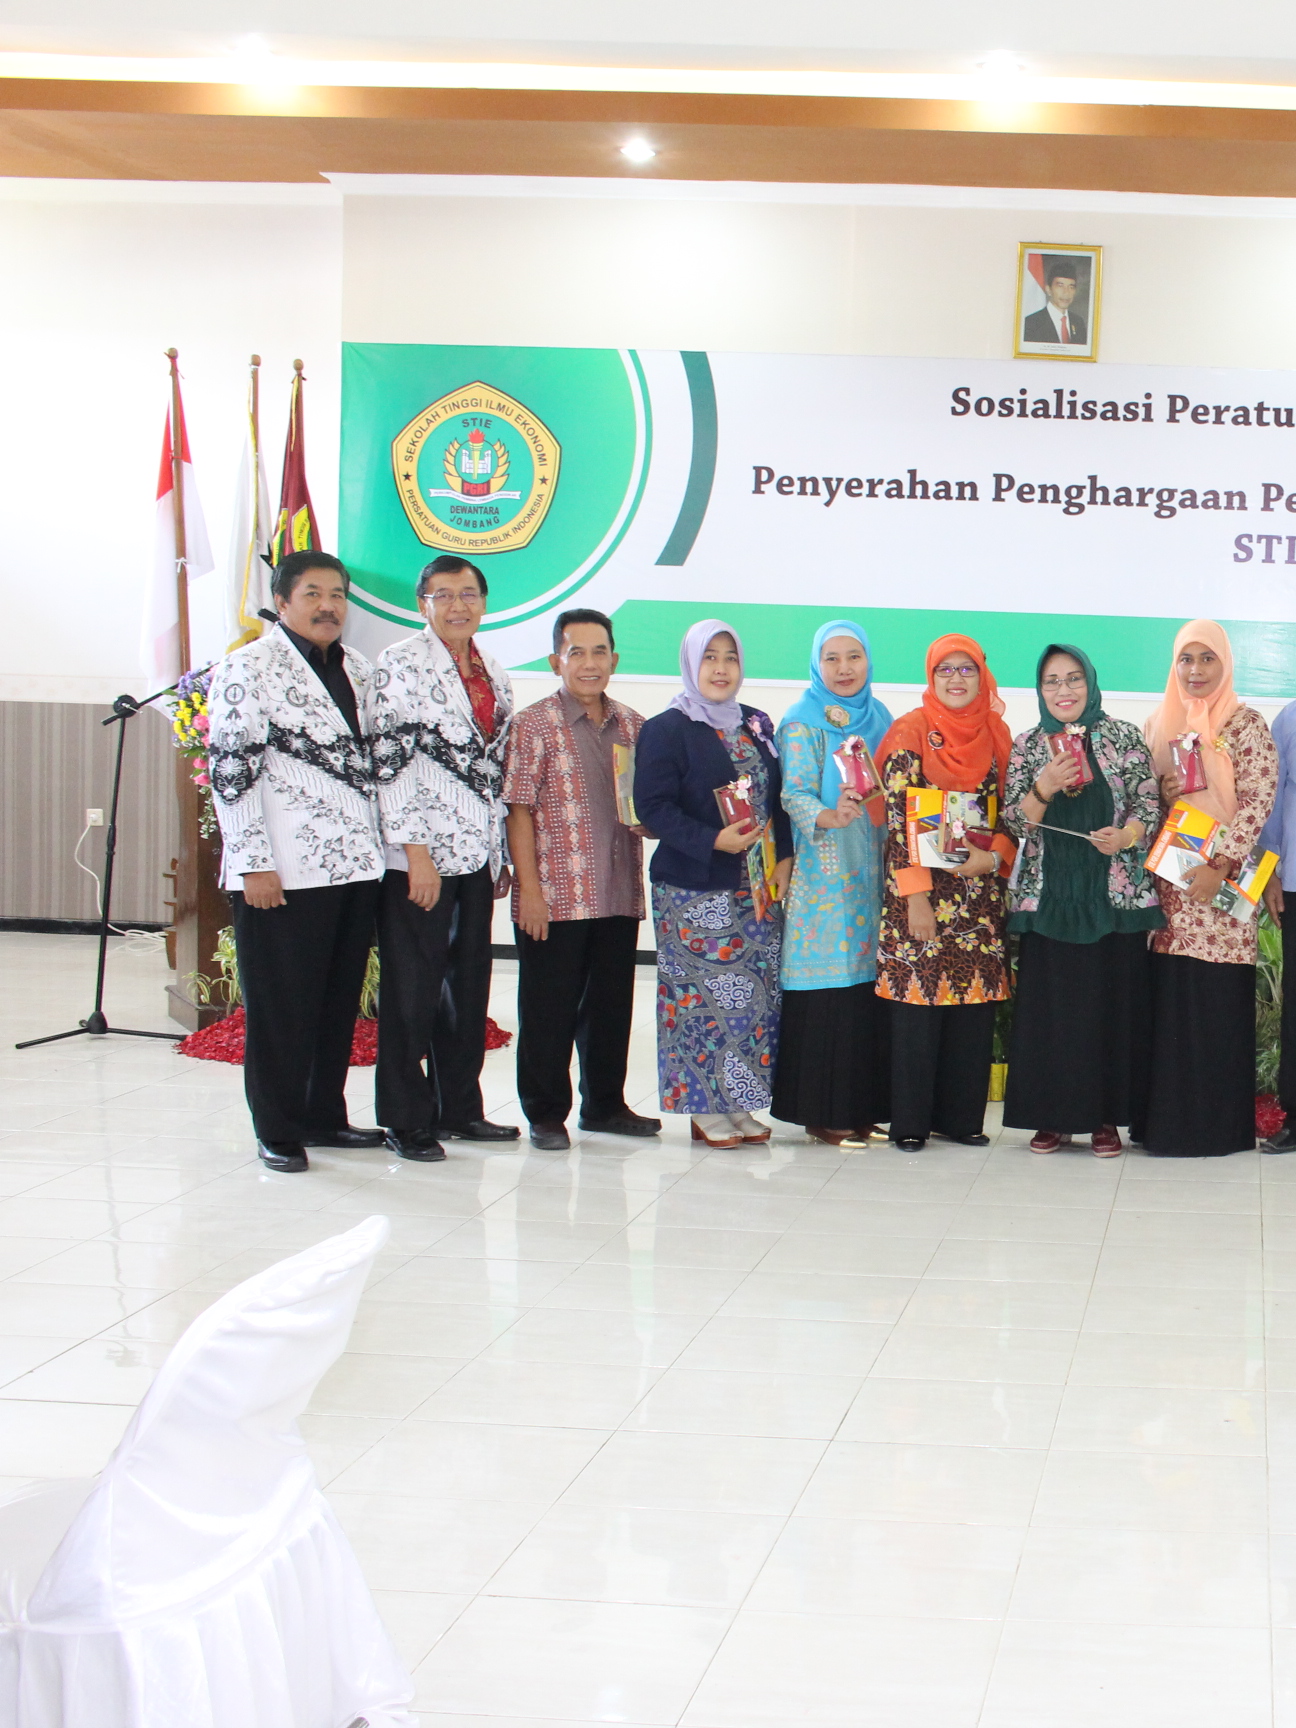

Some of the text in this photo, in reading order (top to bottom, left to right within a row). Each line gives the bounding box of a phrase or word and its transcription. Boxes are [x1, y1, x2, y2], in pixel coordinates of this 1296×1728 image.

[950, 387, 1154, 423] Sosialisasi
[404, 398, 548, 467] SEKOLAH TINGGI ILMU EKONOMI
[461, 417, 493, 429] STIE
[463, 483, 489, 495] PGRI
[751, 465, 980, 508] Penyerahan
[991, 473, 1248, 519] Penghargaan
[405, 488, 545, 547] PERSATUAN GURU REPUBLIK INDONESIA
[450, 505, 500, 515] DEWANTARA
[450, 515, 500, 529] JOMBANG
